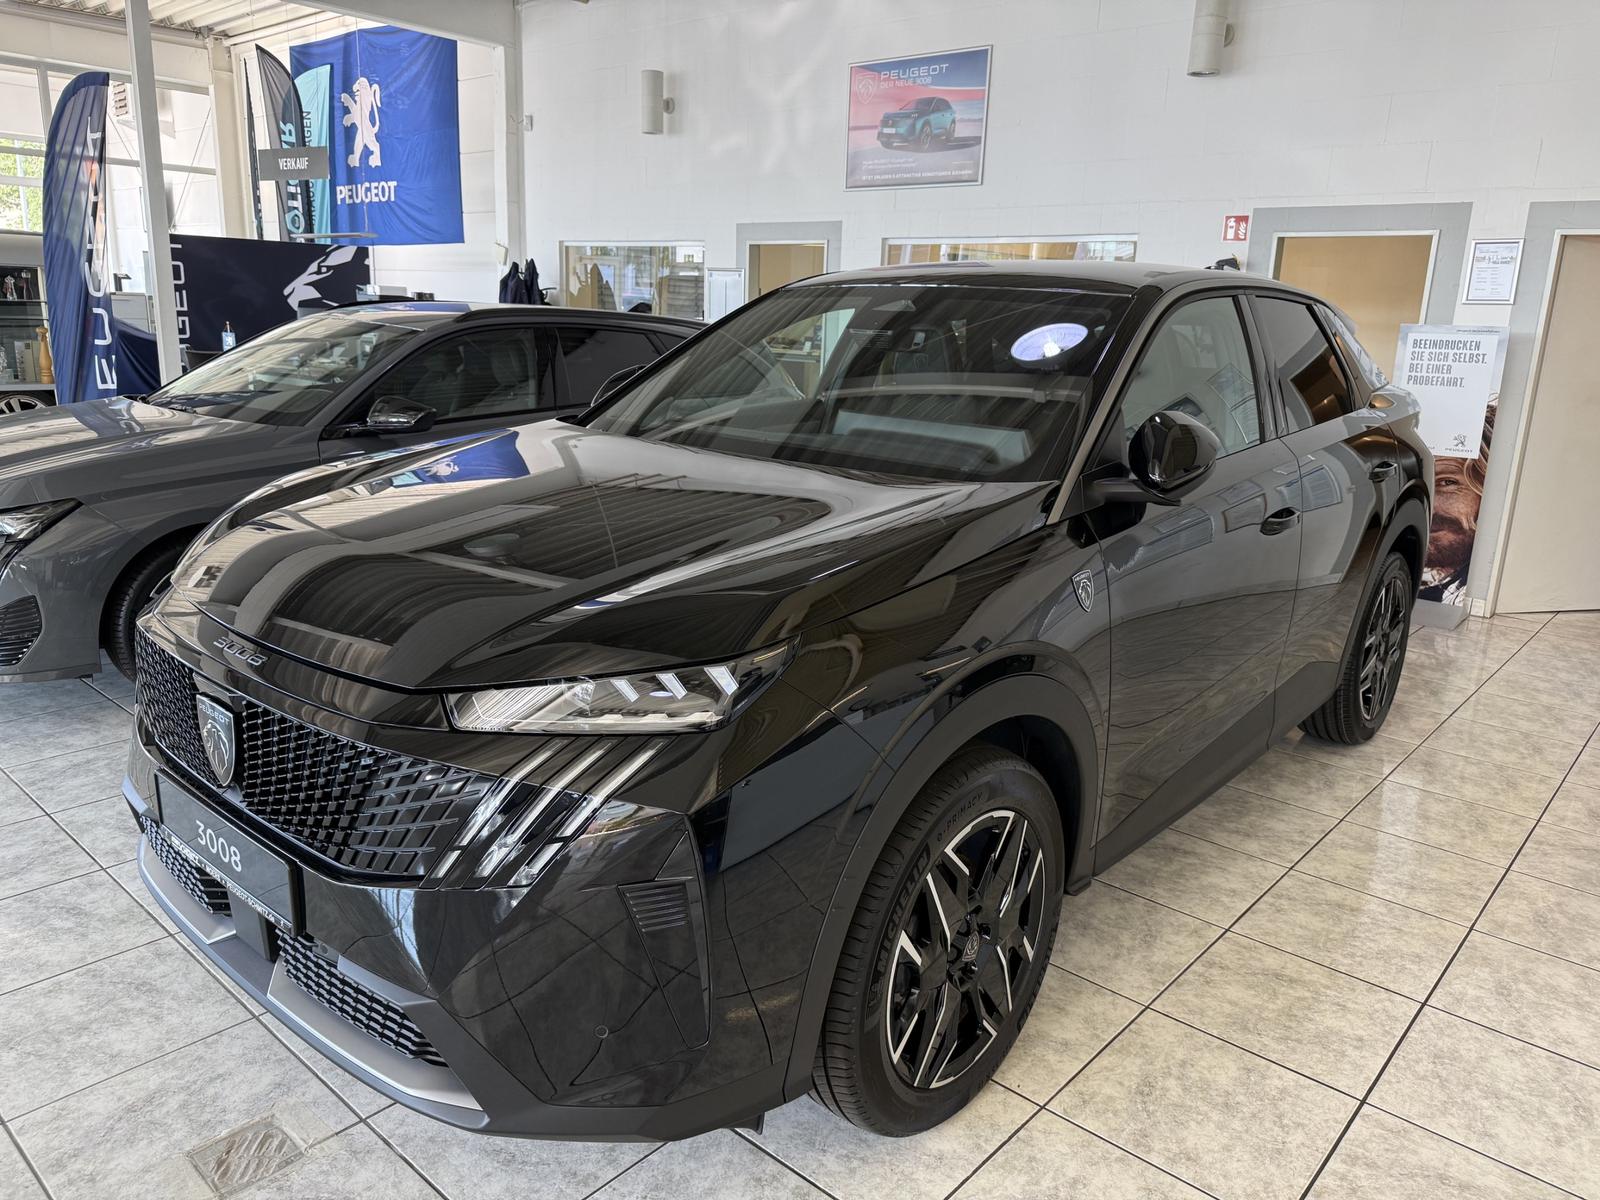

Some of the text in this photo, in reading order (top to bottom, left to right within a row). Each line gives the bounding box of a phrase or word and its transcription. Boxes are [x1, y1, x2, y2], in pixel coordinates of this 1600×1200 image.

[881, 64, 949, 80] PEUGEOT
[895, 79, 914, 87] NEUE
[278, 157, 309, 170] VERKAUF
[336, 181, 397, 205] PEUGEOT
[1412, 338, 1481, 351] BEEINDRUCKEN
[1410, 350, 1487, 364] SIE SICH SELBST.
[1408, 362, 1453, 375] BEI EINER
[1407, 374, 1465, 388] PROBEFAHRT.
[213, 636, 269, 666] 3008
[199, 702, 230, 725] PEUGEOT
[195, 819, 242, 873] 3008
